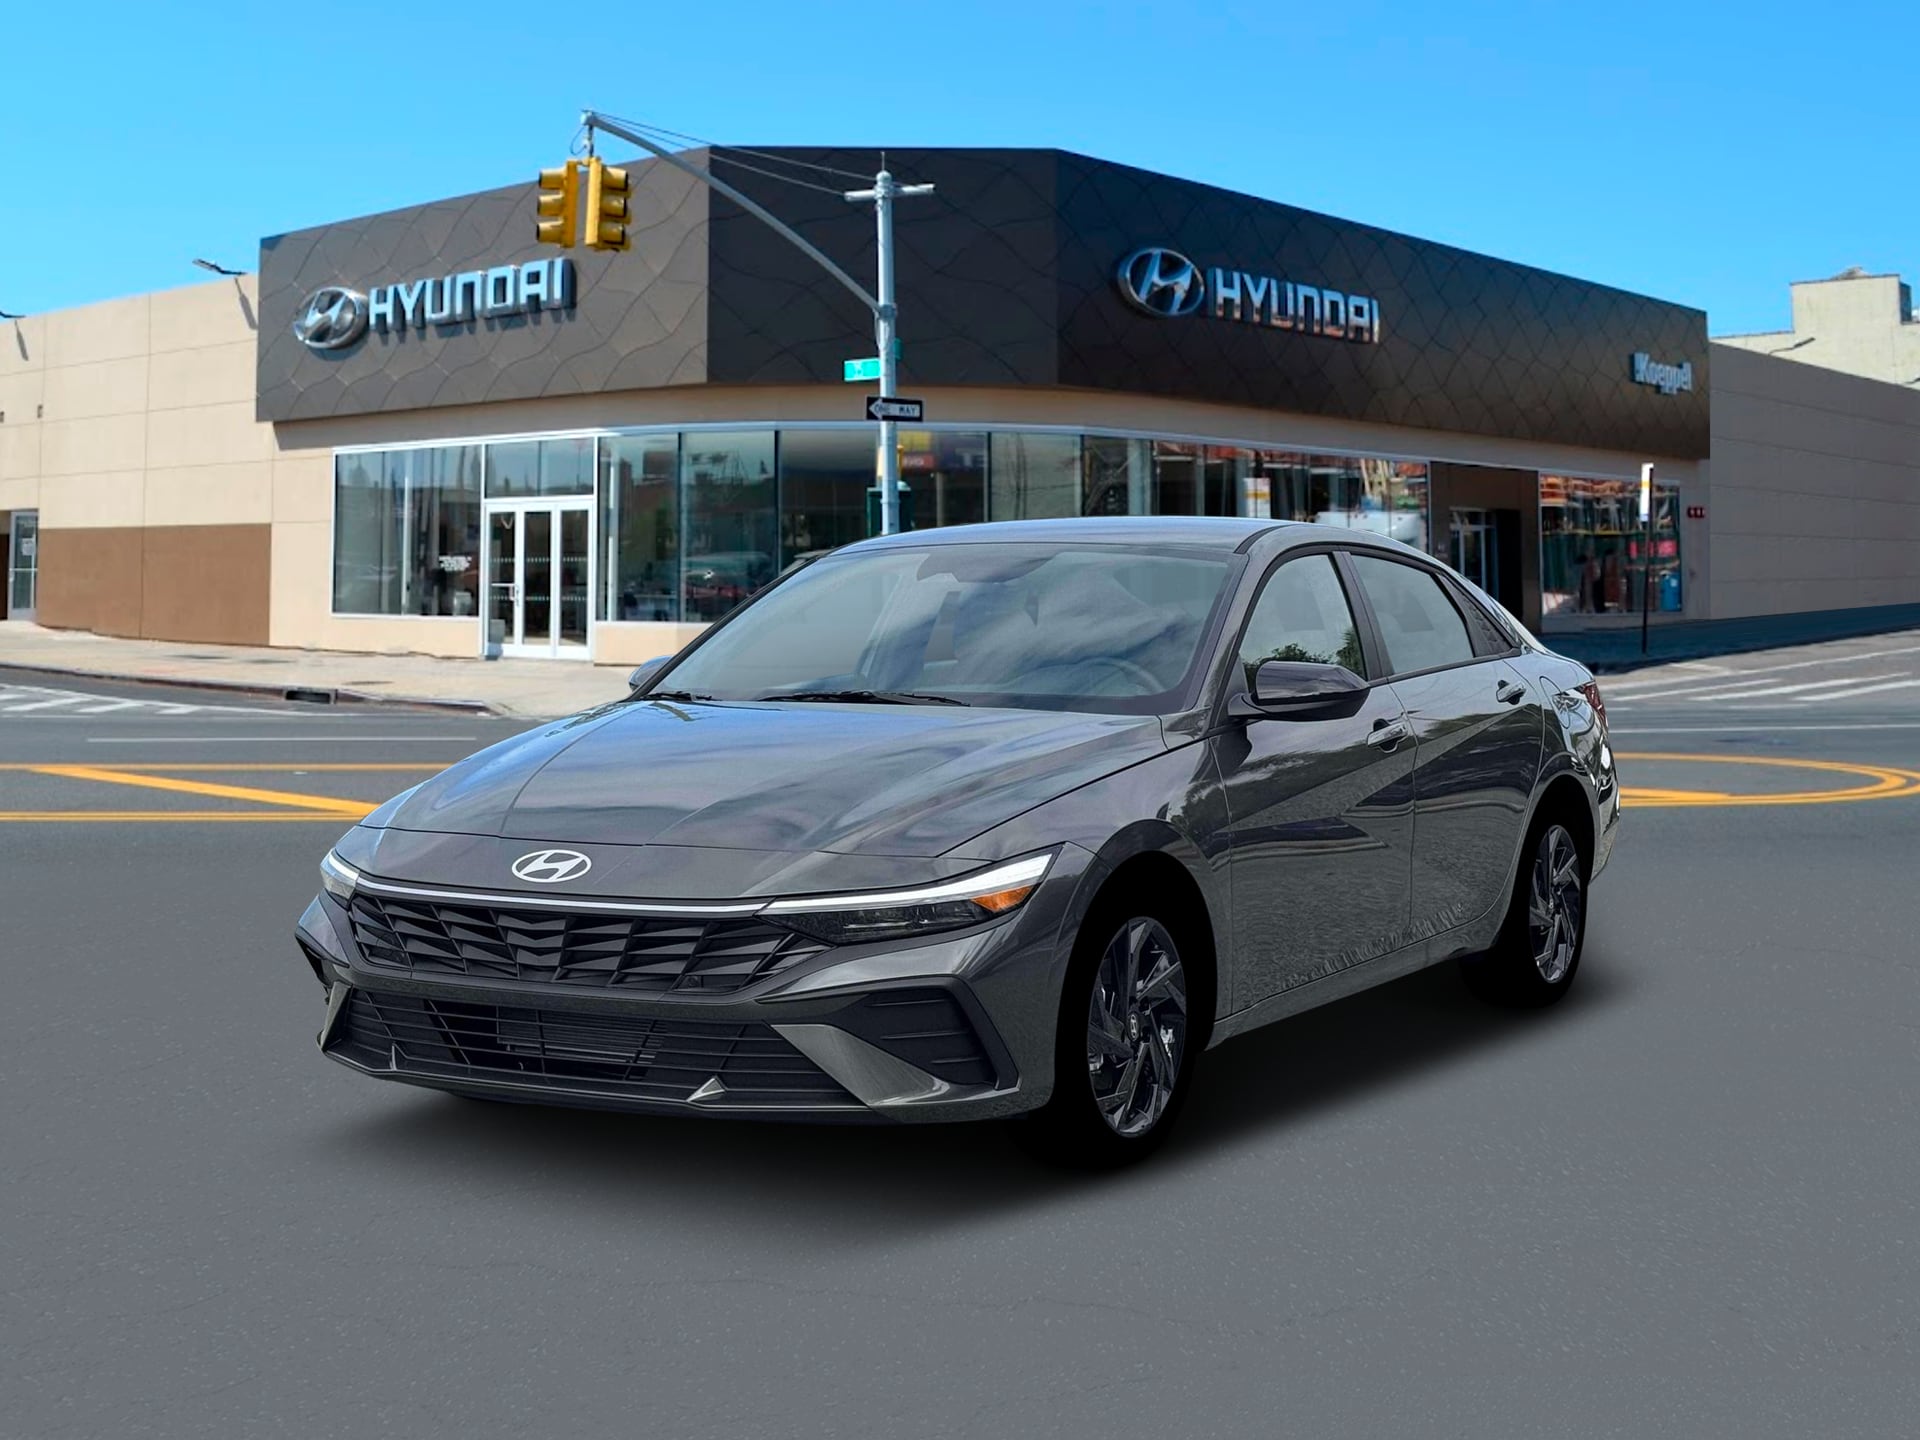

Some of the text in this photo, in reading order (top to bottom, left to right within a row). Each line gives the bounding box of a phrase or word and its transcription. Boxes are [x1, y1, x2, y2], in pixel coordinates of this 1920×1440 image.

[369, 257, 571, 331] HYUNDAI
[1214, 267, 1380, 344] HYUNDAI
[874, 403, 916, 415] ONE WAY
